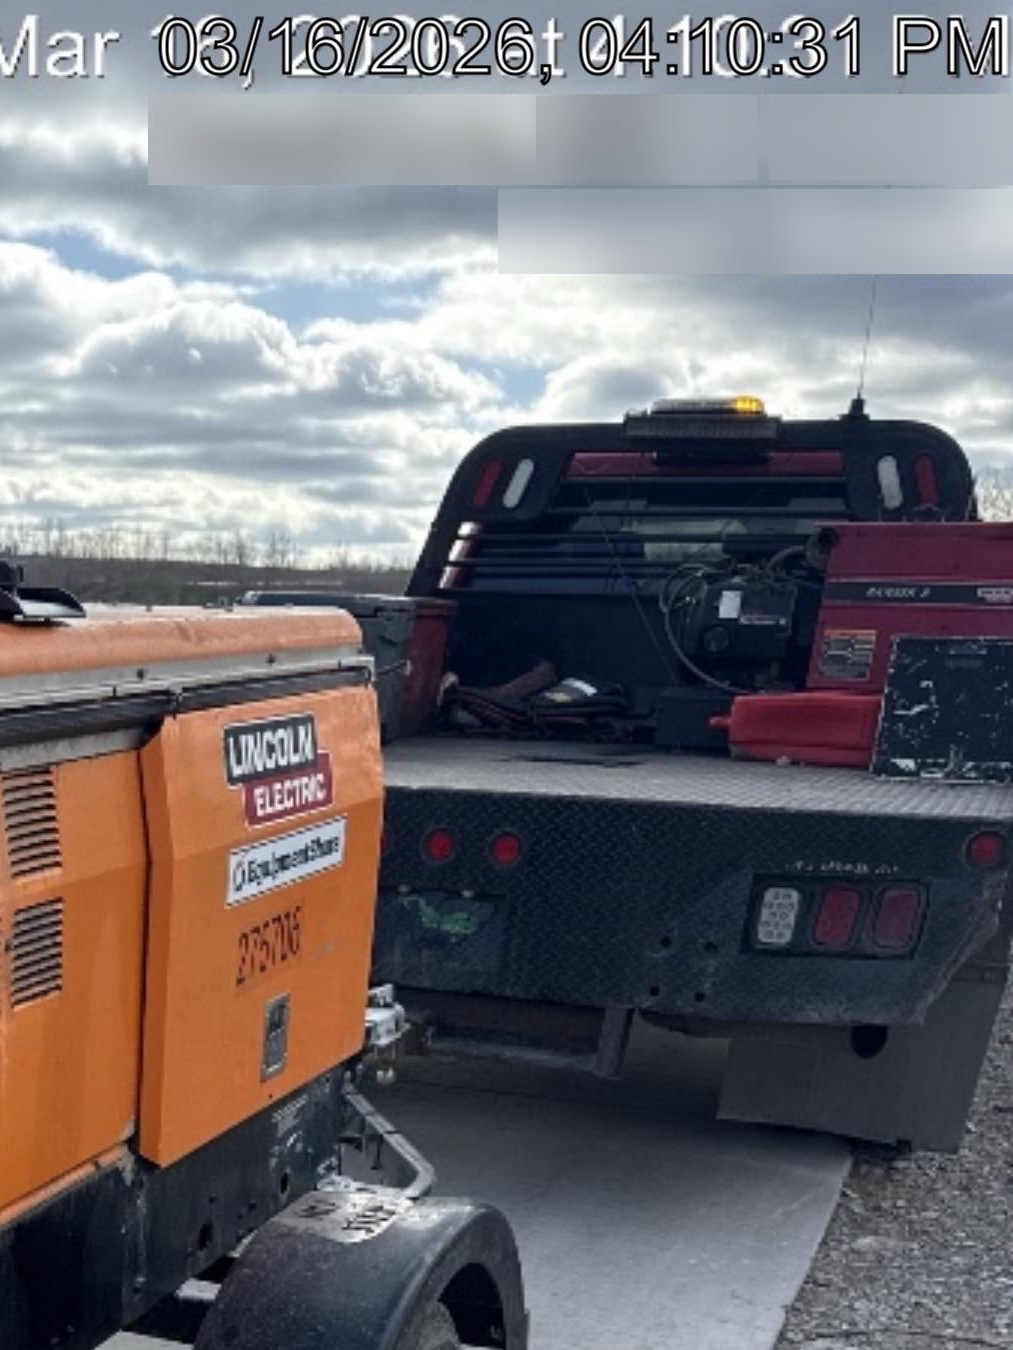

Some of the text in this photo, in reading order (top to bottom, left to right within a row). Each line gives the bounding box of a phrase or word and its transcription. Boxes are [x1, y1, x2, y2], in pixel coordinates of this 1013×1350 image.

[229, 723, 314, 777] LINCOLN
[254, 773, 327, 817] ELECTRIC
[236, 905, 302, 987] 275706
